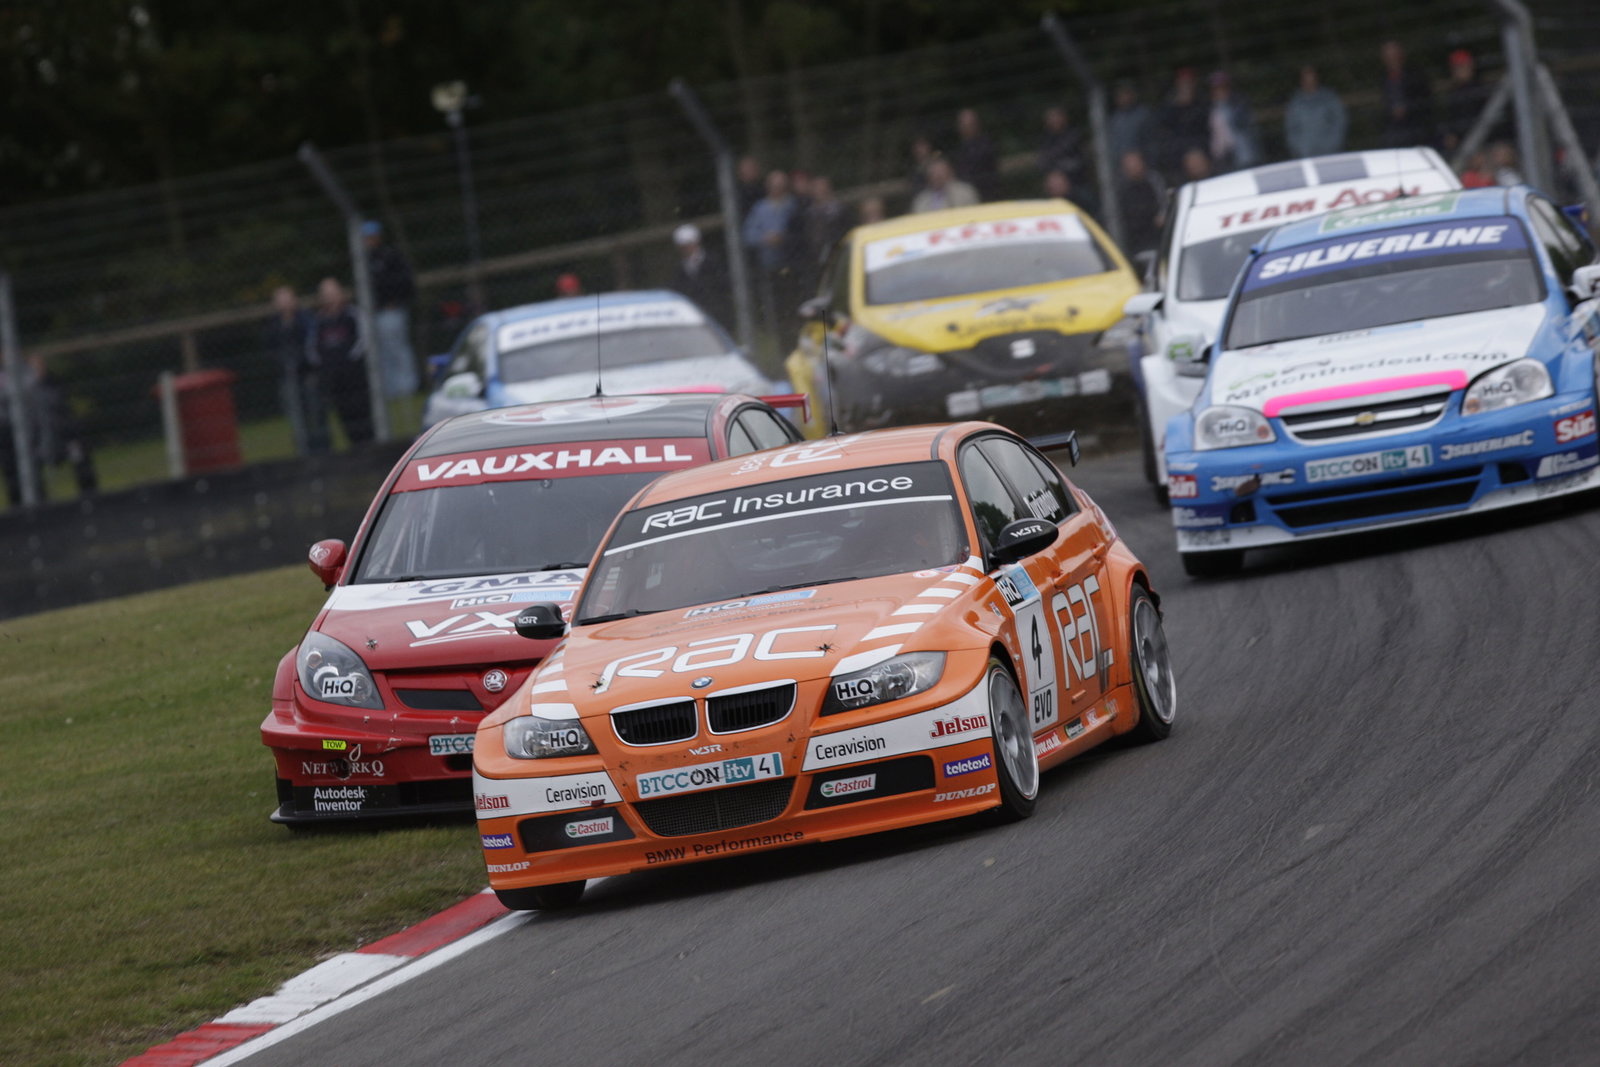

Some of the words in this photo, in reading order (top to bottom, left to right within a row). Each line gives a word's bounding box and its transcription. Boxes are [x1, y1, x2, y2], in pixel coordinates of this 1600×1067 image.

[1218, 198, 1316, 228] TEAM
[1258, 224, 1509, 280] SILVERLINE
[417, 445, 692, 481] VAUXHALL
[733, 476, 914, 514] Insurance
[456, 594, 510, 608] HiQ
[1031, 614, 1042, 680] 4
[324, 680, 354, 694] HiQ
[837, 679, 873, 699] HiQ
[1034, 688, 1052, 724] evo
[930, 715, 988, 738] Jelson
[326, 741, 343, 749] TOW
[550, 730, 579, 747] HiQ
[815, 736, 886, 760] Ceravision
[371, 760, 384, 776] Q
[725, 760, 751, 780] itv
[759, 757, 771, 774] 4
[946, 755, 990, 775] teletext
[314, 786, 365, 799] Autodesk
[546, 782, 606, 803] Ceravision
[835, 777, 872, 793] Castrol
[933, 783, 996, 802] DUNLOP
[314, 800, 362, 811] Inventor
[578, 821, 609, 834] Castrol
[645, 848, 686, 864] BMW
[693, 831, 804, 856] Performance
[487, 862, 530, 873] DUNLOP
